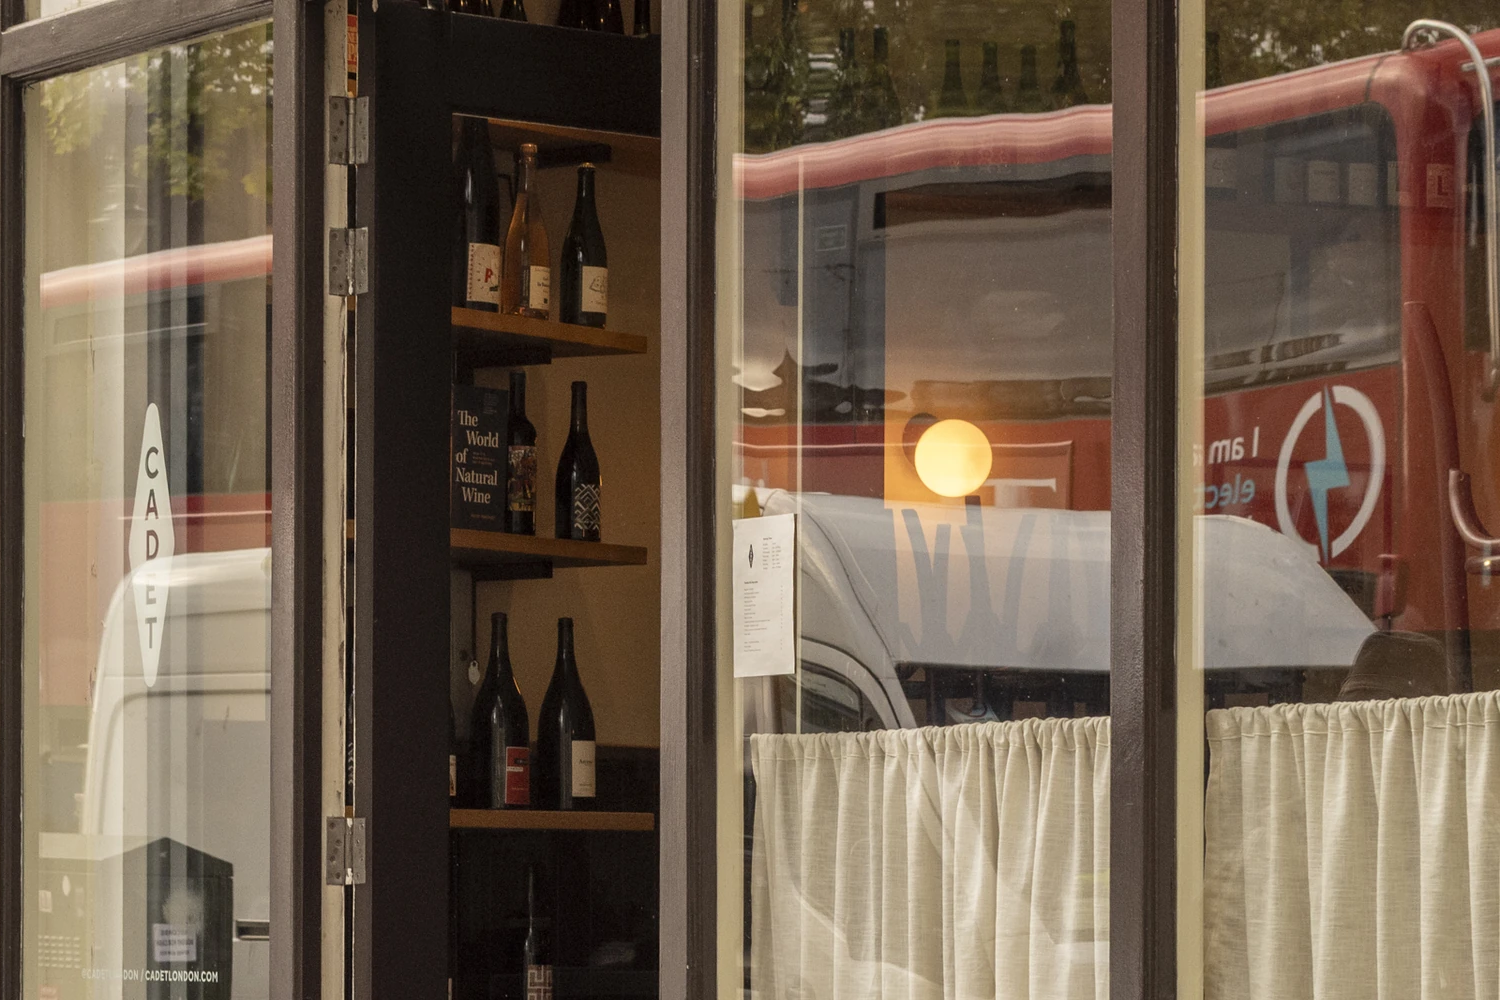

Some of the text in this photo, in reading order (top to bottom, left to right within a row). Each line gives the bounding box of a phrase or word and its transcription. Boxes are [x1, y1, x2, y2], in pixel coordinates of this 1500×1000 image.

[457, 409, 478, 427] The
[465, 429, 499, 448] World
[455, 447, 469, 464] of
[455, 467, 498, 486] Natural
[461, 486, 491, 504] Wine
[144, 446, 159, 649] CADET
[81, 968, 139, 981] @CADETLDON
[145, 970, 219, 983] CADETLONDON.COM
